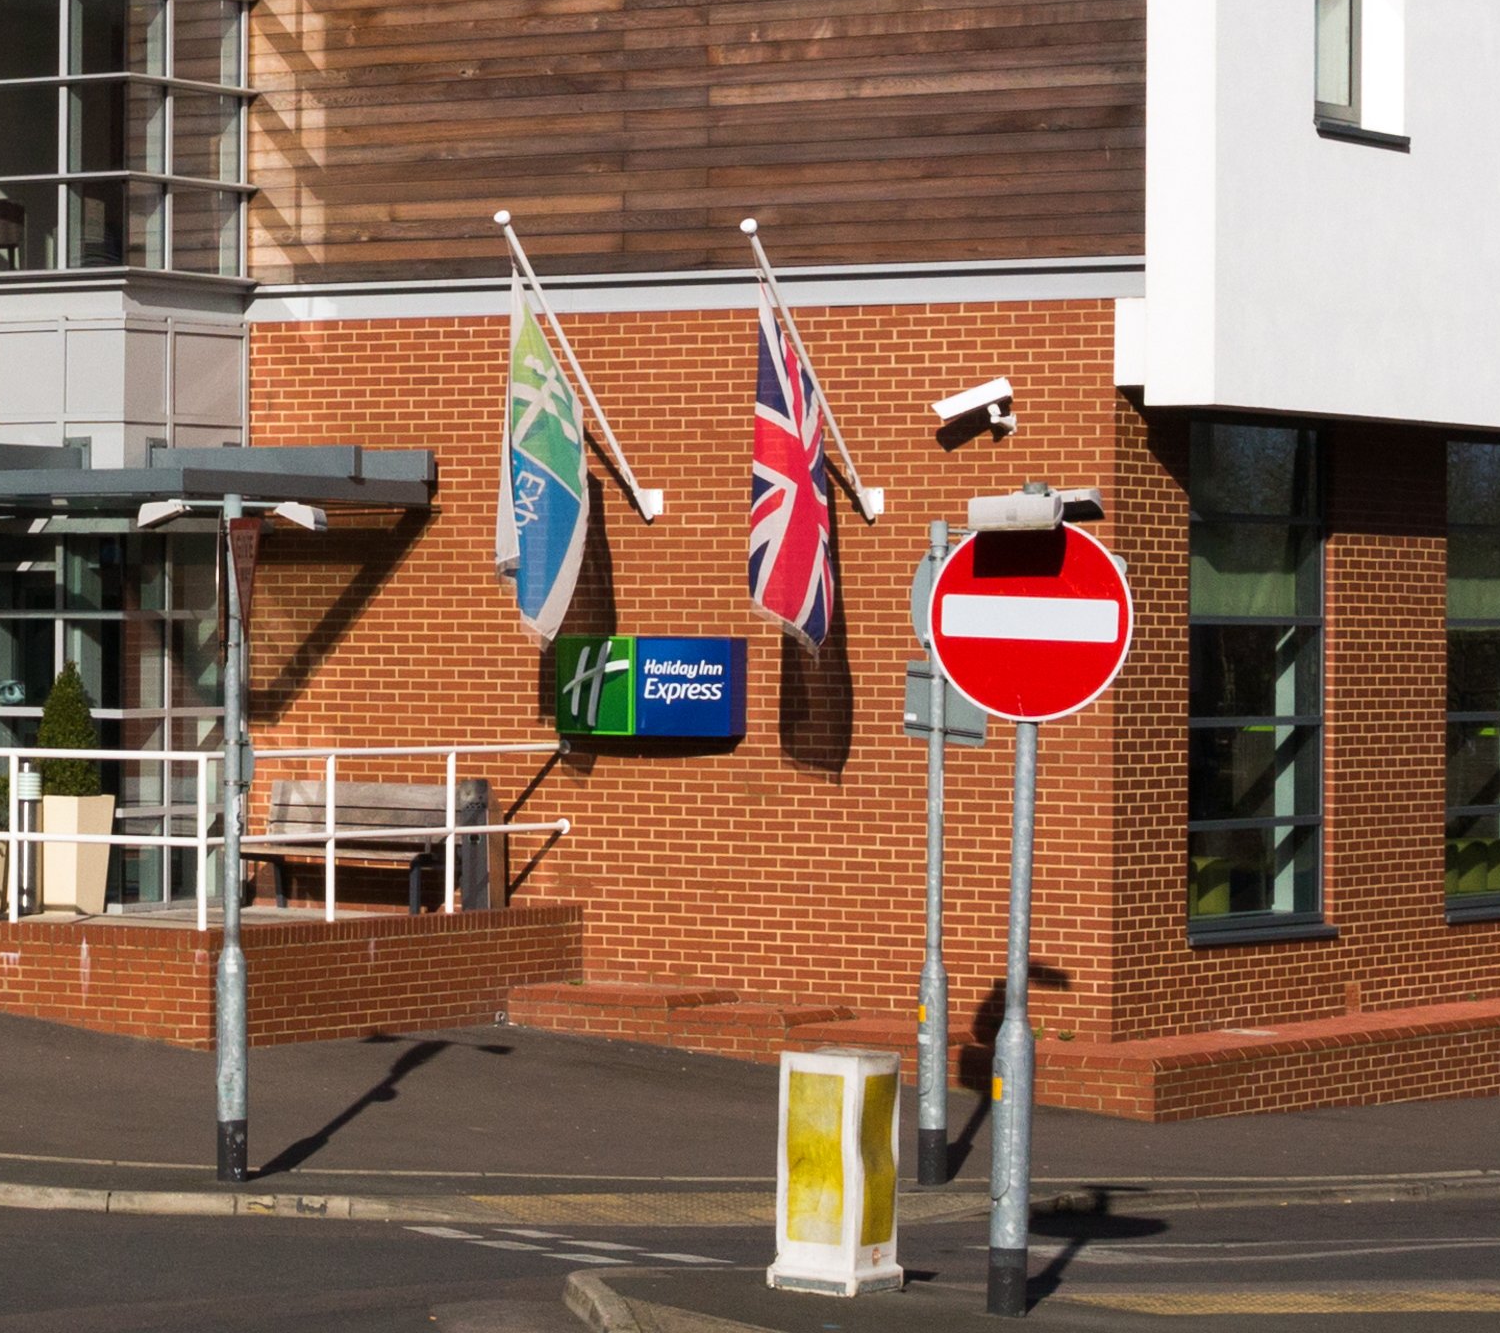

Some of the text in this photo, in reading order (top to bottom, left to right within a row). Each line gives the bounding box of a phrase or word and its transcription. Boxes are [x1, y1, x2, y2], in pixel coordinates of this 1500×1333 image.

[644, 658, 723, 679] Holiday Inn
[643, 677, 723, 705] Express
